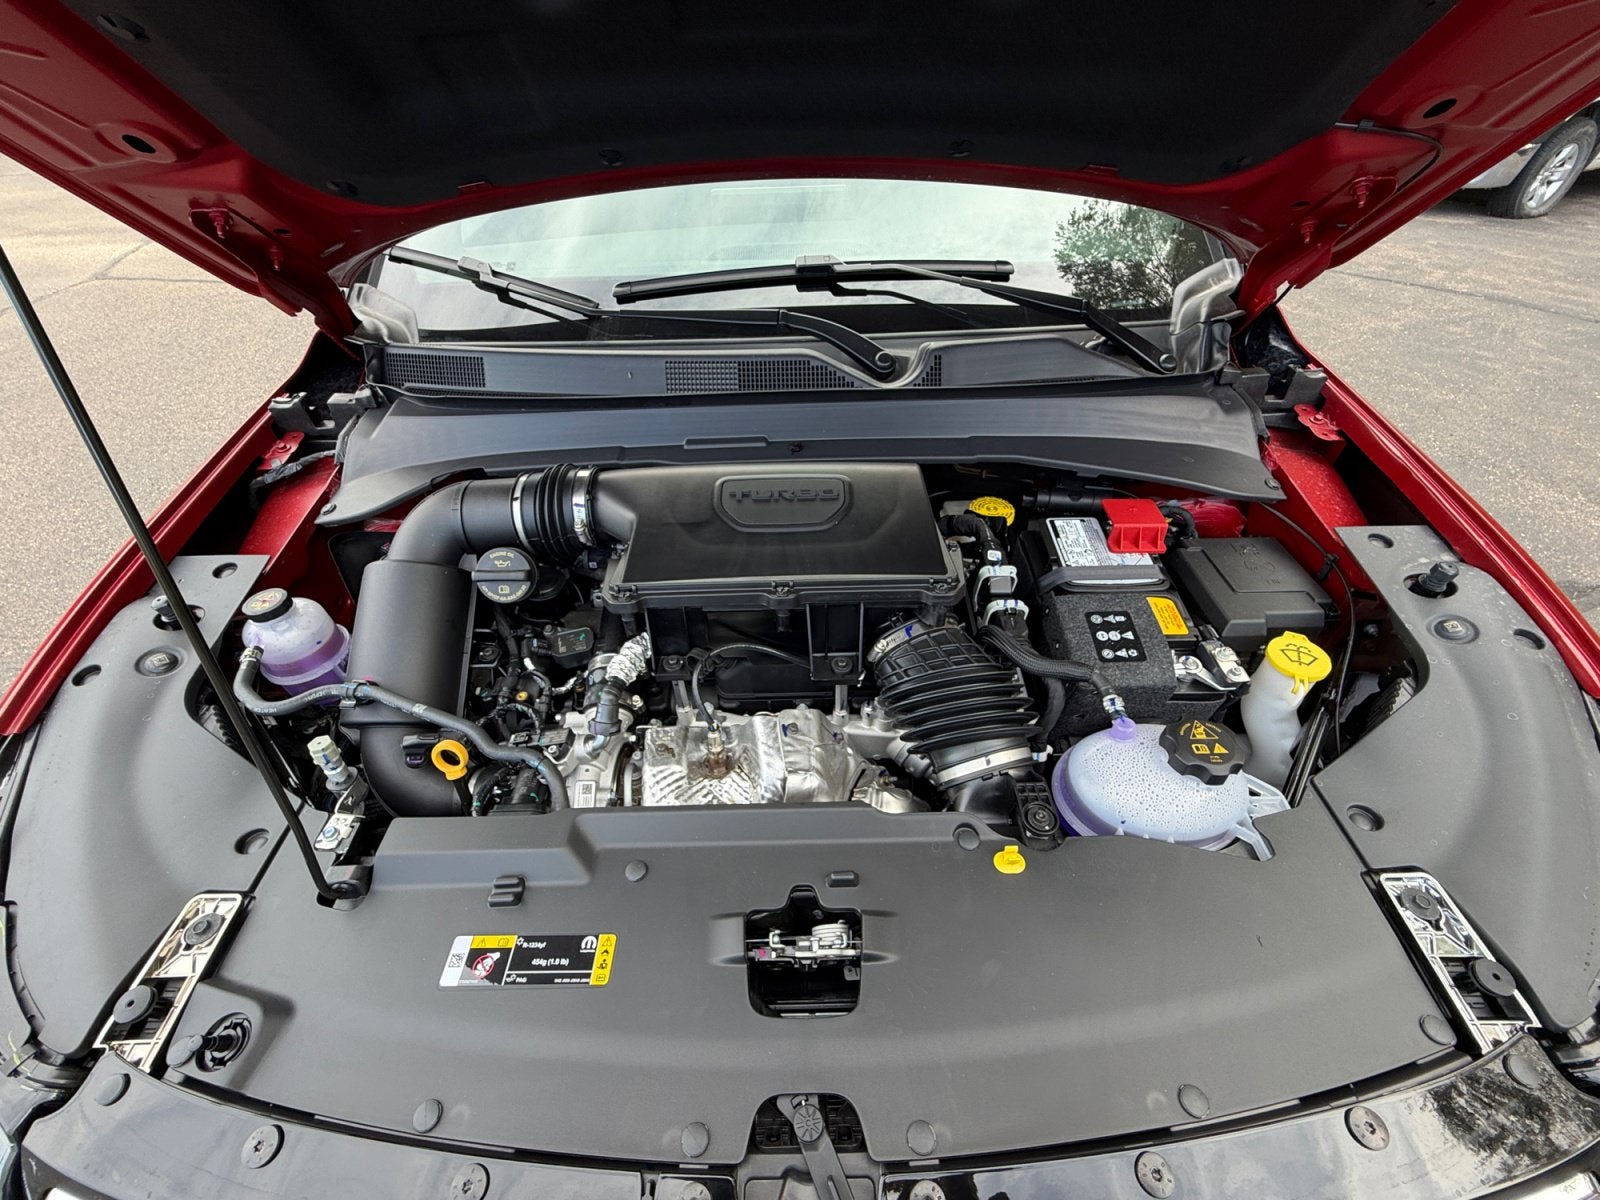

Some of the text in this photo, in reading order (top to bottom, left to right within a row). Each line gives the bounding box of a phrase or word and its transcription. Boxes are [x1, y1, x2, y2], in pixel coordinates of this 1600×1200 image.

[728, 487, 840, 503] TURBO
[531, 958, 570, 967] 454g (1.0 lb)
